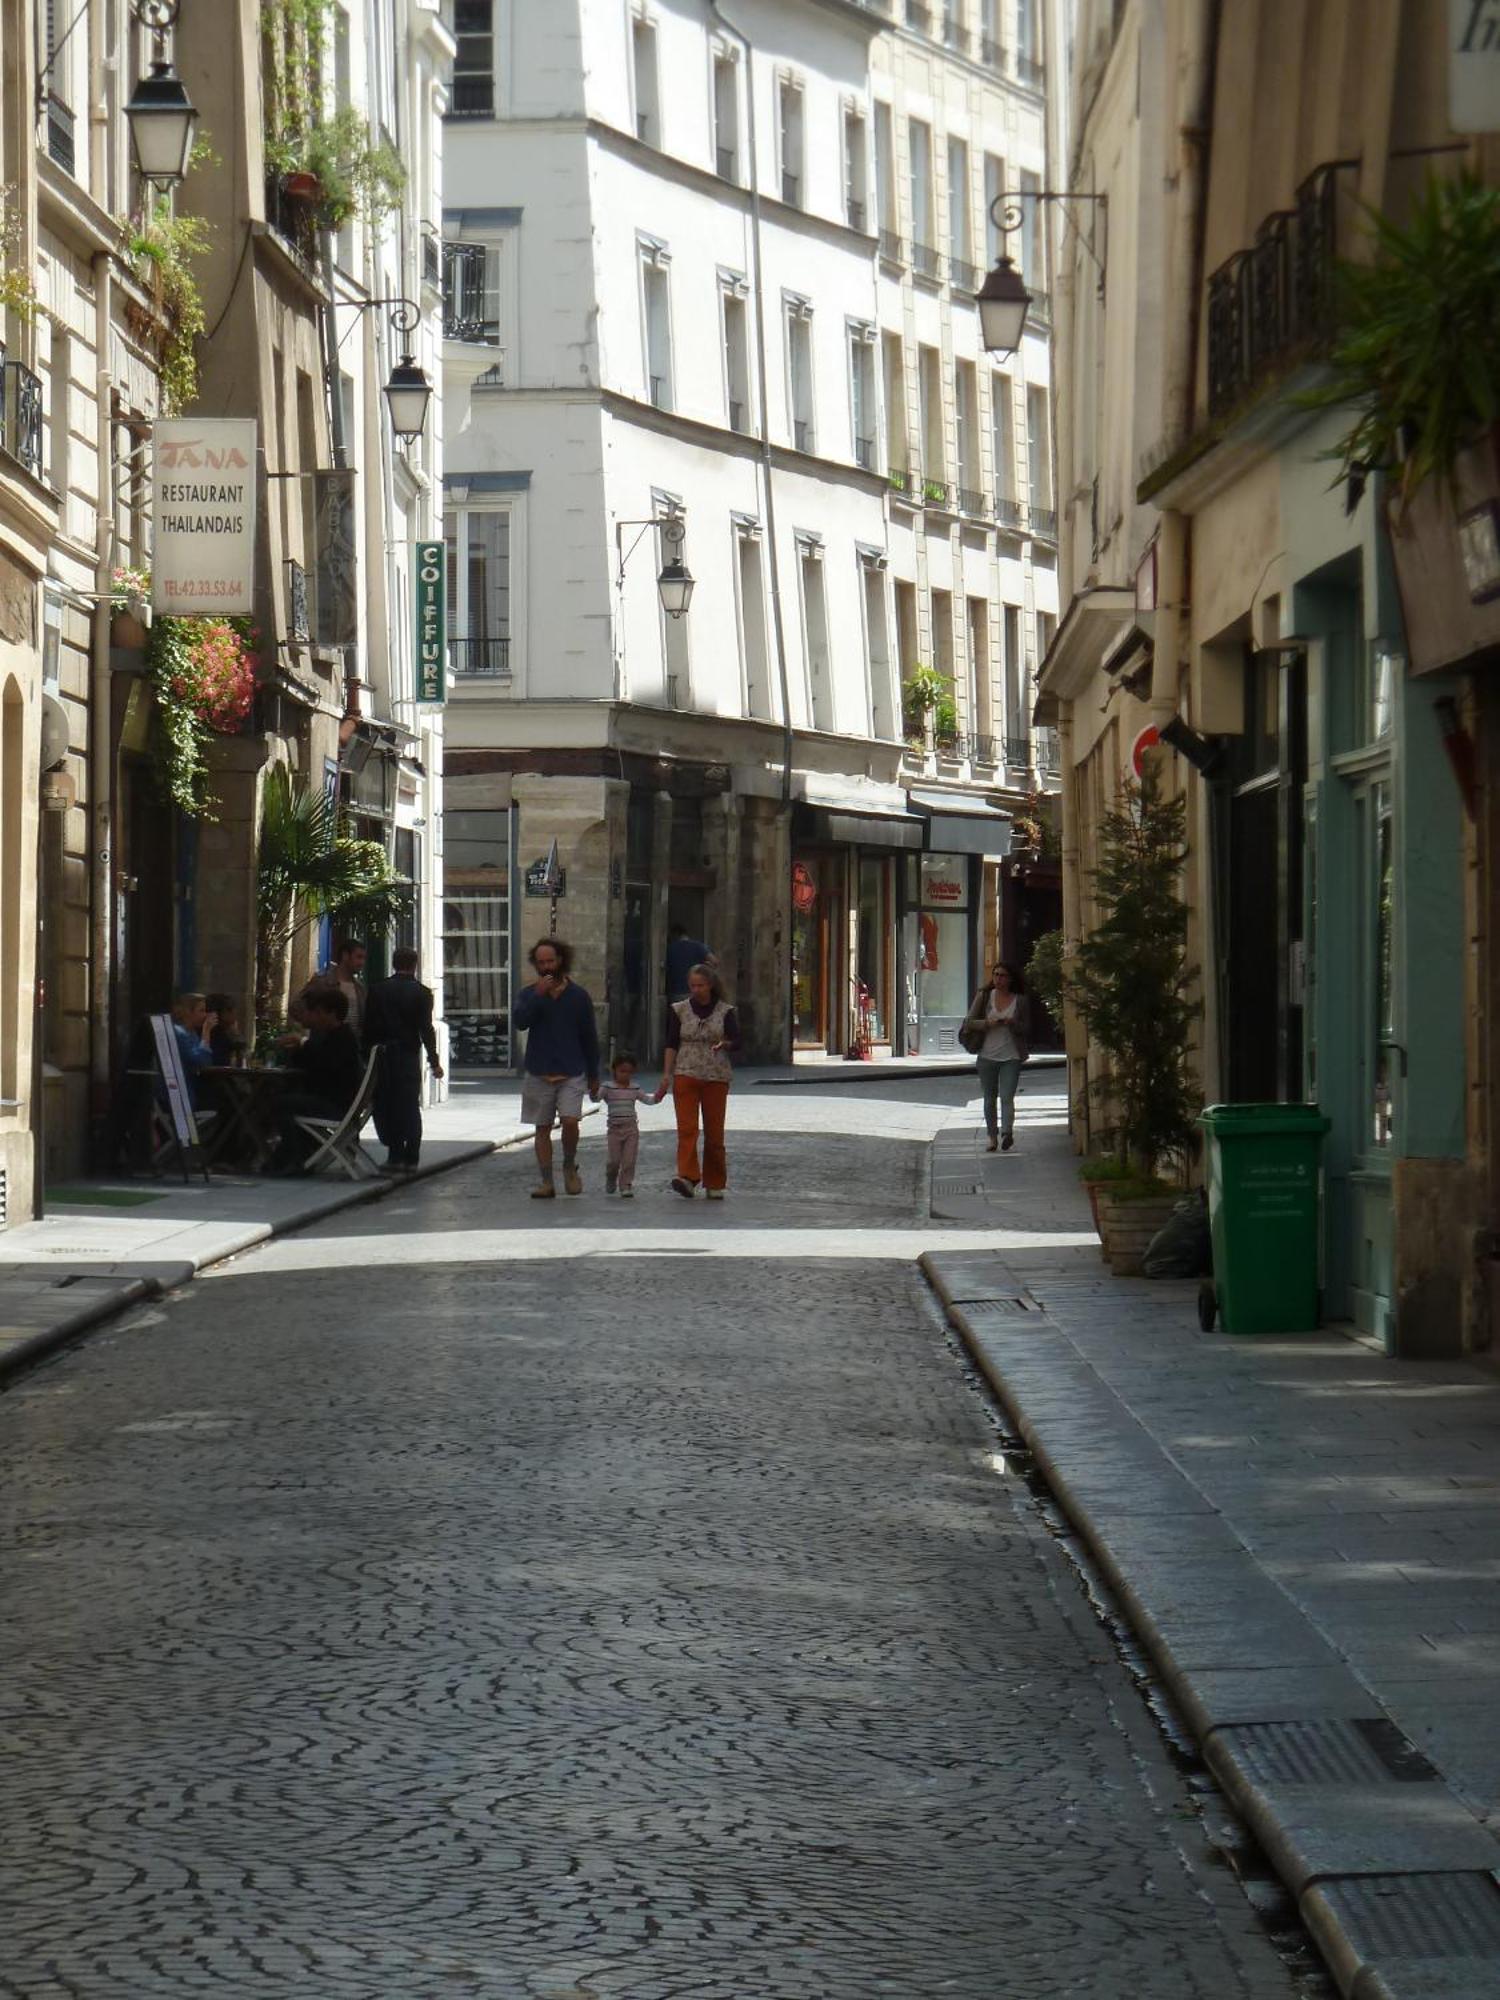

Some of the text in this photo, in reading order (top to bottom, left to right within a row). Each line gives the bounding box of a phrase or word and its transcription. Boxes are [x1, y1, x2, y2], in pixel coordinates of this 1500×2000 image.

[160, 440, 248, 470] TANA
[161, 484, 243, 502] RESTAURANT
[161, 515, 243, 534] THAILANDAIS
[420, 547, 440, 698] COIFFURE
